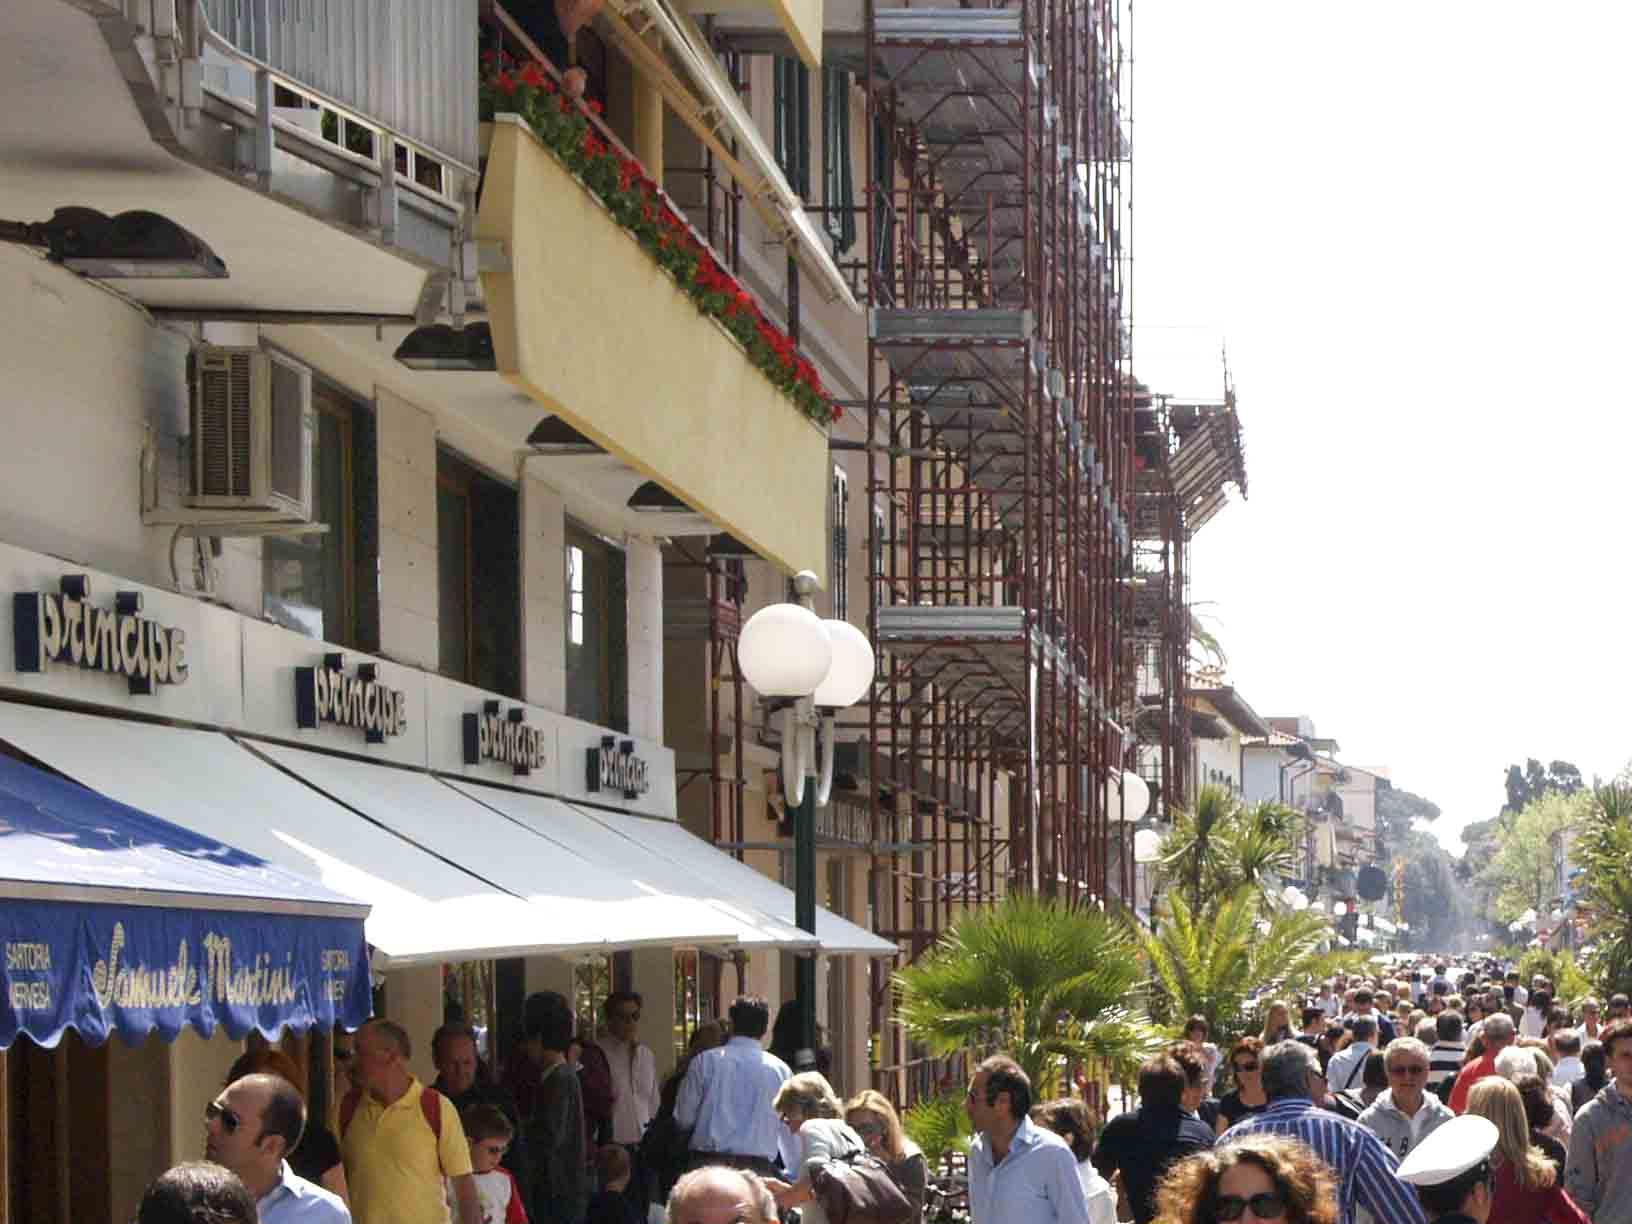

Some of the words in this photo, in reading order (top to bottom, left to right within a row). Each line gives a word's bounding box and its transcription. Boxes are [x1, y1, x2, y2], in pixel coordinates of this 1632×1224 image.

[14, 574, 190, 697] principe
[295, 653, 407, 744] principe
[463, 700, 545, 776] principe
[6, 943, 51, 970] SARTORIA
[203, 931, 296, 1006] Martini
